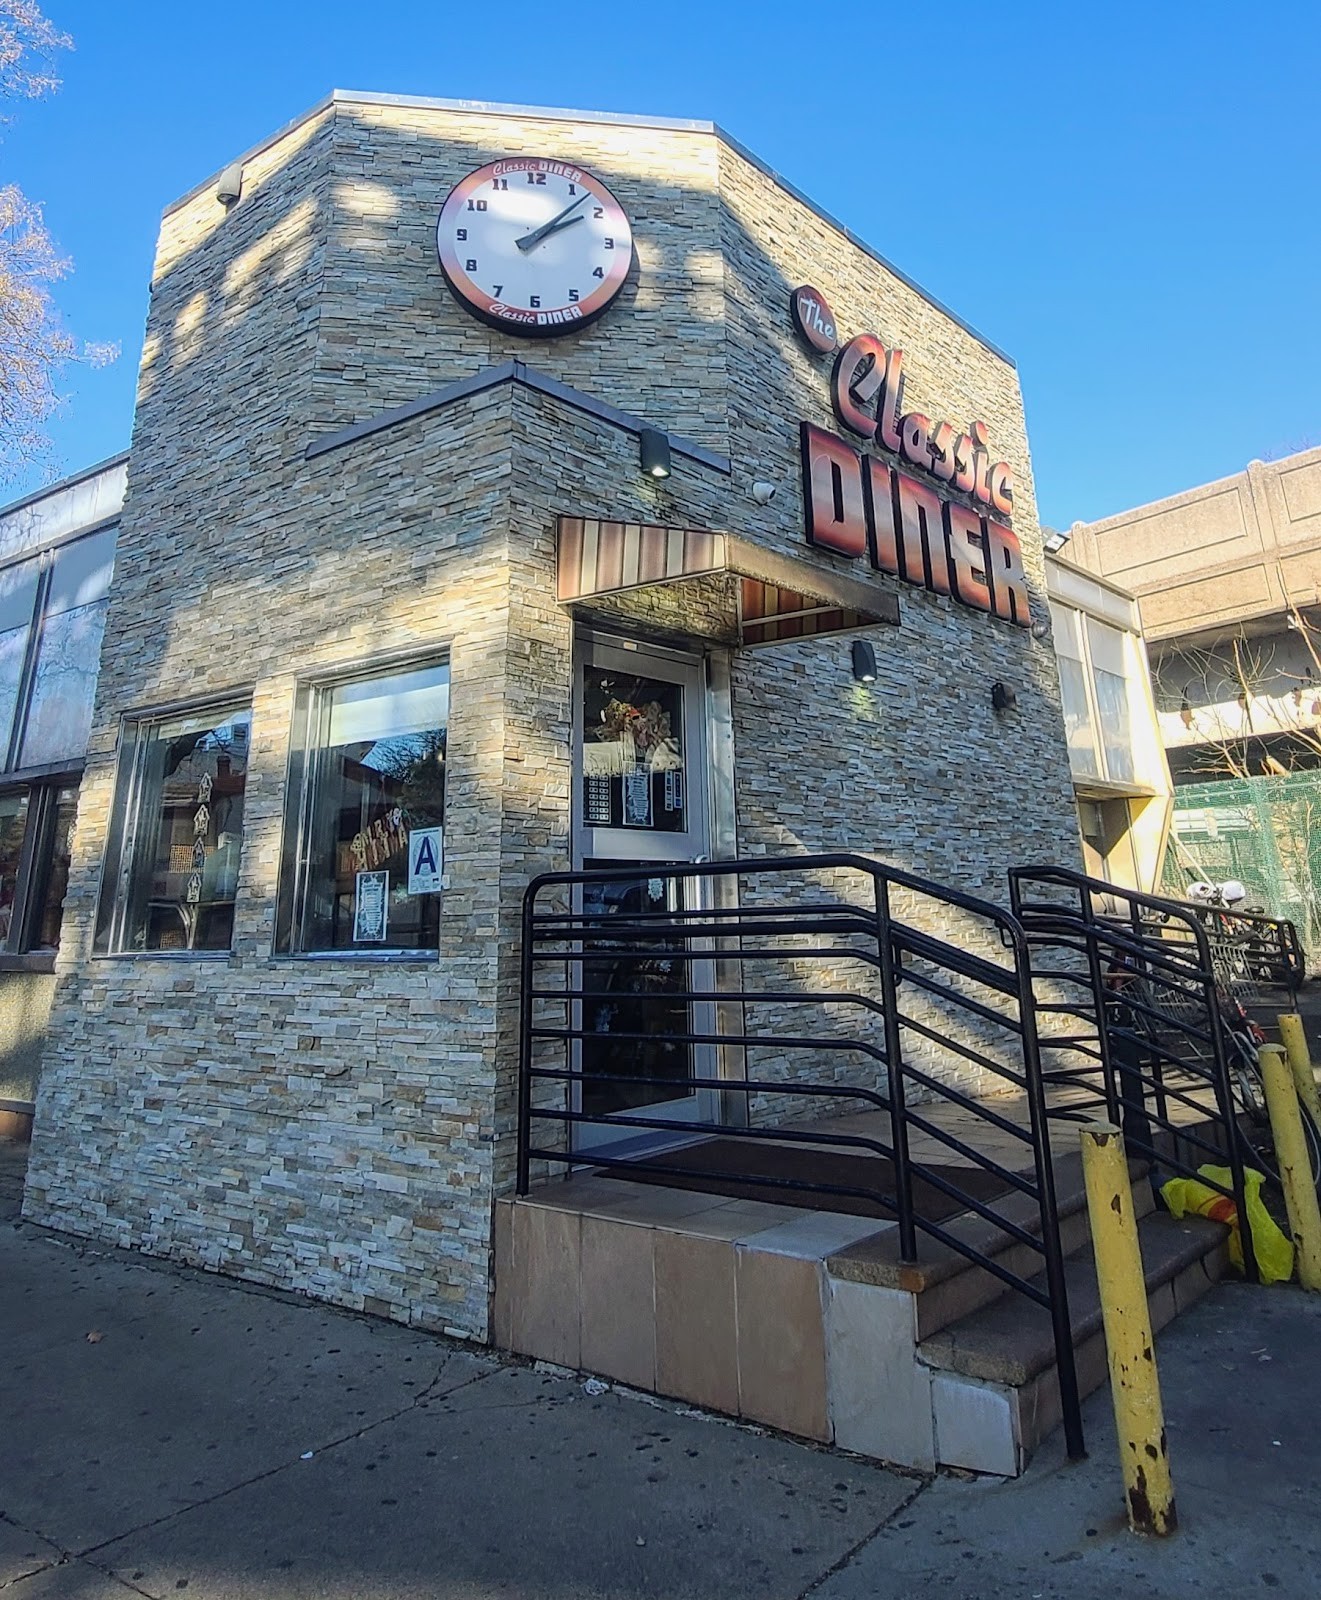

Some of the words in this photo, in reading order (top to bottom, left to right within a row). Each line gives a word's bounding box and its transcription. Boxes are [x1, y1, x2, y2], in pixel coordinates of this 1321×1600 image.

[492, 161, 536, 176] Classic
[538, 160, 583, 183] DINER
[492, 179, 508, 191] 11
[527, 172, 546, 185] 12
[568, 184, 576, 196] 1
[467, 199, 487, 212] 10
[593, 207, 604, 219] 2
[456, 228, 467, 241] 9
[604, 237, 614, 250] 3
[465, 259, 477, 272] 8
[592, 266, 604, 279] 4
[492, 285, 503, 298] 7
[568, 289, 579, 302] 5
[530, 295, 540, 308] 6
[489, 303, 535, 324] Classic
[537, 306, 583, 326] DINER
[799, 296, 834, 340] The
[831, 333, 1013, 516] Classic
[800, 420, 1031, 628] DINER
[414, 836, 437, 876] A
